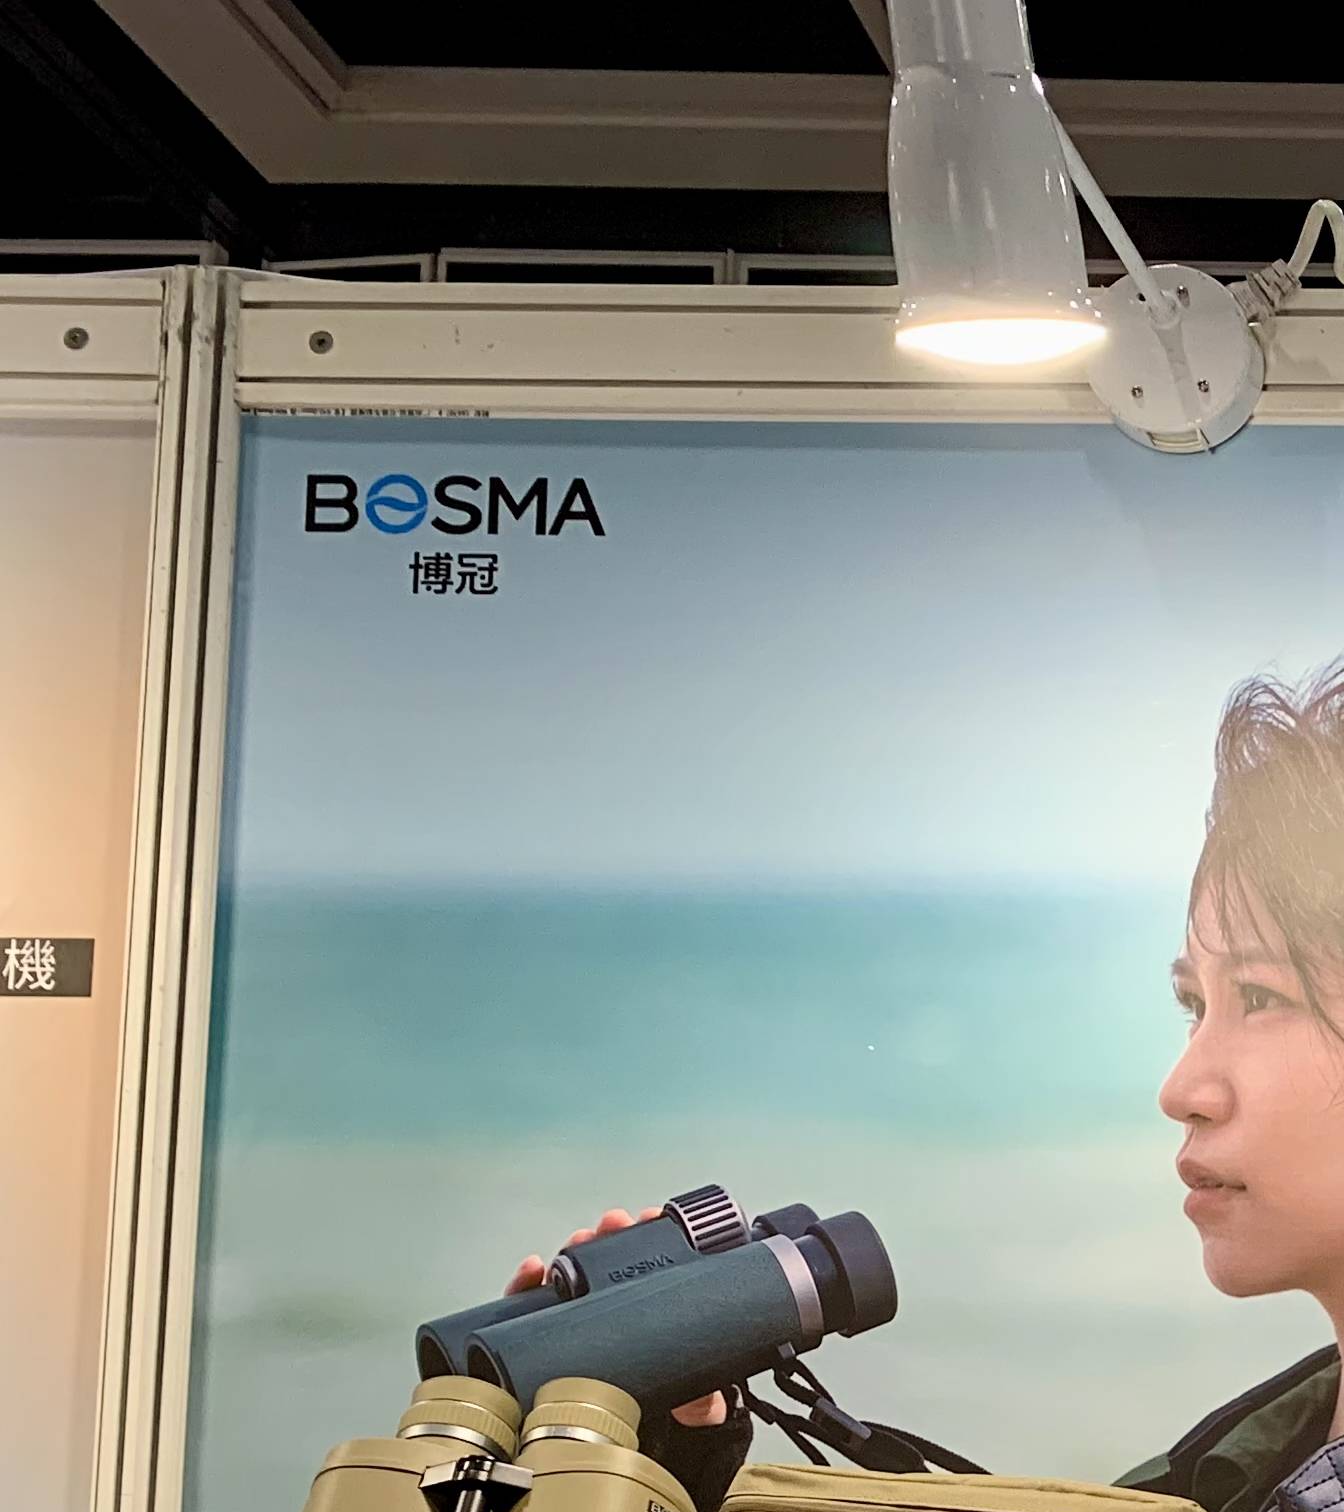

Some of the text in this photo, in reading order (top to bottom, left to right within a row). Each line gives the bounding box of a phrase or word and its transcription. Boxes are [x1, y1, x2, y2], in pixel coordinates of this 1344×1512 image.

[305, 473, 606, 537] BOSMA
[408, 551, 499, 595] 博冠
[1, 938, 57, 991] 機
